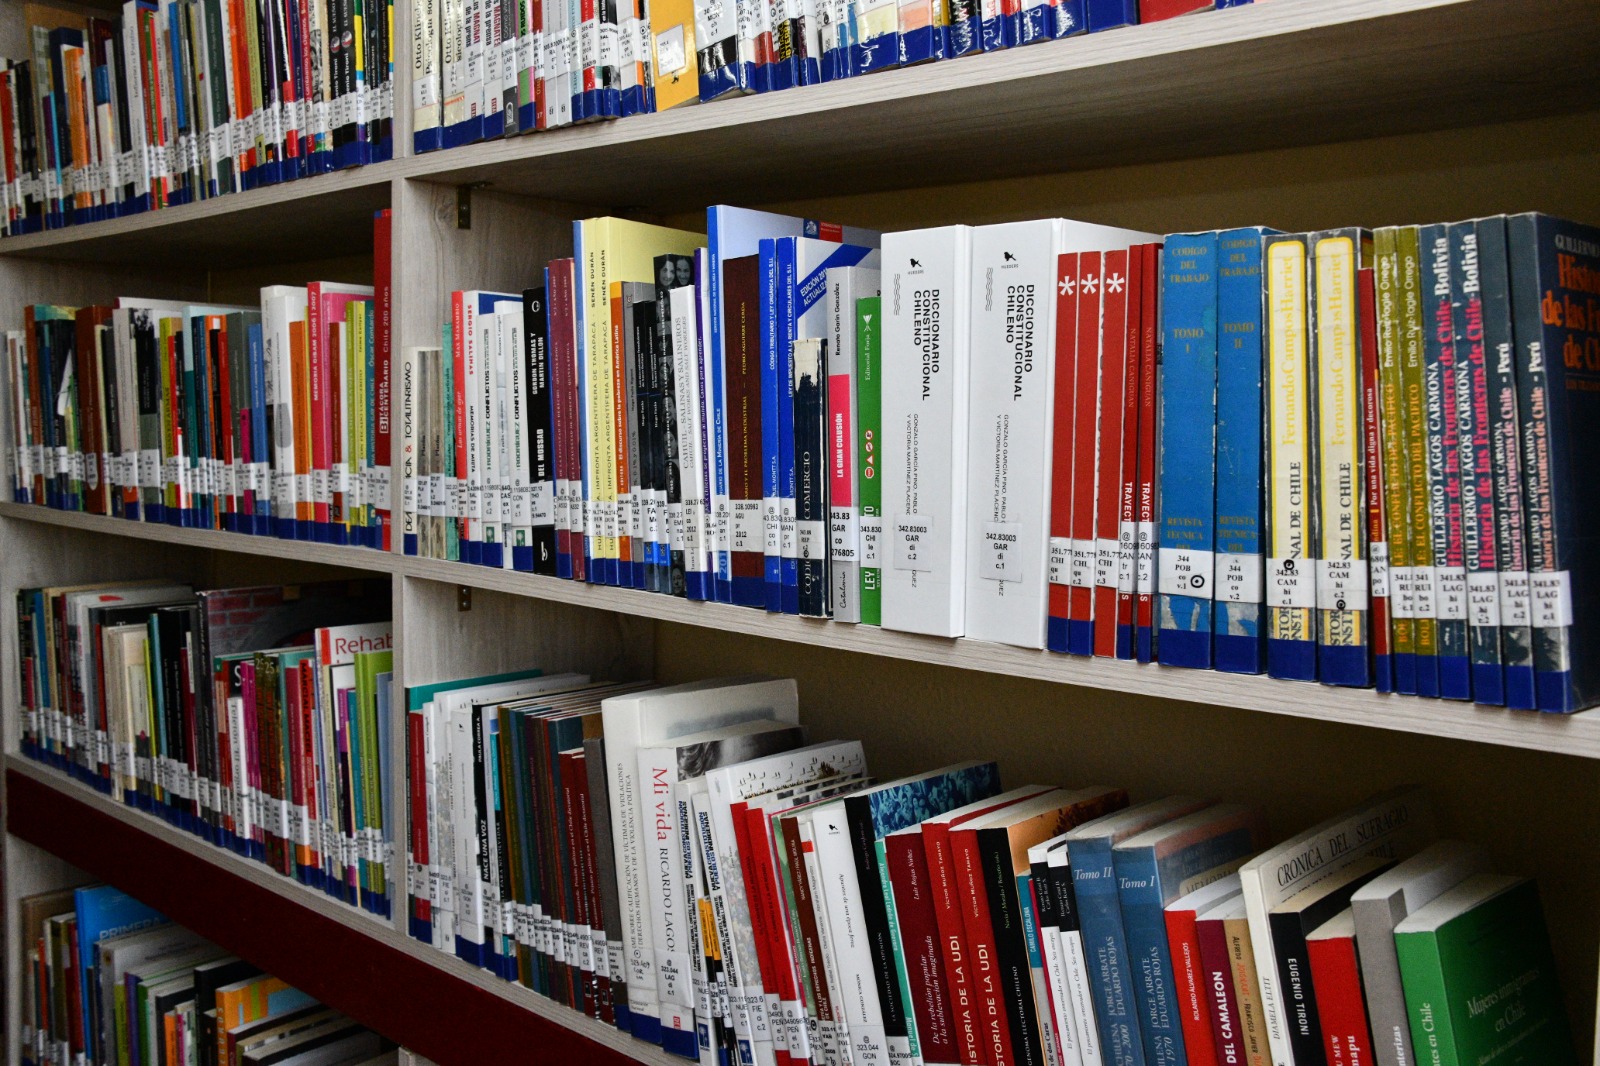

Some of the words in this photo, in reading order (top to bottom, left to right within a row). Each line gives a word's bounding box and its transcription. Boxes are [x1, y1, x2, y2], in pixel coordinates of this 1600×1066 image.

[1180, 260, 1197, 270] DEL
[1229, 252, 1246, 263] DEL
[1169, 273, 1209, 284] TRABAJO
[1219, 266, 1259, 277] TRABAJO
[1404, 256, 1415, 289] Orrego
[914, 290, 922, 346] CHILENO
[1006, 286, 1015, 344] CHILENO
[1541, 290, 1563, 328] de
[1564, 294, 1586, 332] las
[931, 289, 940, 374] DICCIONARIO
[1024, 284, 1034, 372] DICCIONARIO
[1173, 328, 1204, 339] TOMO
[1223, 322, 1254, 333] TOMO
[675, 317, 684, 373] SALINEROS
[922, 290, 931, 400] CONSTITUCIONAL
[1014, 284, 1025, 401] CONSTITUCIONAL
[1408, 340, 1418, 367] Emilio
[1564, 334, 1583, 368] de
[404, 362, 412, 438] TOTALITARISMO
[678, 380, 687, 424] SALINAS
[1427, 362, 1442, 431] CARMONA
[1458, 360, 1472, 431] CARMONA
[1430, 434, 1443, 480] LAGOS
[1462, 434, 1474, 481] LAGOS
[802, 452, 812, 520] COMERCIO
[1290, 462, 1301, 506] CHILE
[1339, 462, 1352, 508] CHILE
[832, 524, 846, 532] GAR
[898, 526, 928, 534] 342.83003
[1167, 517, 1204, 527] REVISTA
[1220, 515, 1256, 526] REVISTA
[1290, 510, 1301, 528] DE
[1340, 512, 1352, 531] DE
[1432, 485, 1447, 567] GUILLERMO
[1464, 485, 1479, 569] GUILLERMO
[986, 532, 1017, 542] 342.83003
[993, 542, 1008, 551] GAR
[908, 552, 917, 560] c.2
[995, 561, 1005, 570] c.1
[1051, 556, 1064, 564] CHI
[1073, 560, 1087, 568] CHI
[1098, 559, 1113, 567] CHI
[1175, 564, 1191, 572] POB
[1228, 564, 1242, 572] 344
[1328, 561, 1351, 570] 342.83
[864, 571, 876, 590] LEY
[1226, 574, 1244, 582] POB
[1276, 568, 1299, 577] 342.83
[1277, 578, 1298, 586] CAM
[1334, 591, 1345, 599] c.2
[617, 762, 625, 808] VIOLACIONES
[652, 768, 668, 794] Mi
[620, 809, 627, 818] DE
[656, 802, 672, 841] vida
[1278, 847, 1324, 887] CRONICA
[1328, 832, 1349, 856] DEL
[1356, 804, 1408, 843] SUFRAGIO
[624, 854, 630, 863] DE
[659, 848, 674, 909] RICARDO
[1074, 868, 1100, 880] Tomo
[1103, 866, 1112, 878] II
[1119, 877, 1147, 889] Tomo
[1149, 875, 1155, 886] I
[625, 865, 634, 912] CALIFICACIÓN
[1023, 907, 1032, 928] ESCALONA
[950, 936, 961, 961] UDI
[1027, 930, 1036, 952] CAMILO
[1106, 936, 1119, 967] ROJAS
[978, 944, 990, 971] UDI
[1150, 946, 1163, 977] ROJAS
[921, 955, 932, 986] popular
[956, 966, 964, 983] LA
[1142, 957, 1156, 994] ARRATE
[959, 988, 968, 1005] DE
[984, 976, 993, 992] LA
[1112, 970, 1126, 1016] EDUARDO
[1262, 976, 1275, 1003] ELTIT
[925, 989, 936, 1022] rebelión
[987, 998, 996, 1015] DE
[1156, 979, 1170, 1028] EDUARDO
[1213, 970, 1233, 1035] CAMALEON
[1287, 958, 1303, 1000] EUGENIO
[1295, 1003, 1309, 1036] TIRONI
[1149, 998, 1161, 1028] JORGE
[1266, 1005, 1281, 1040] DIAMELA
[1420, 1002, 1435, 1032] Chile
[1505, 1004, 1526, 1026] Chile
[933, 1032, 939, 1044] De
[1331, 1035, 1340, 1057] MEW
[1430, 1034, 1437, 1048] en
[1226, 1039, 1237, 1064] DEL
